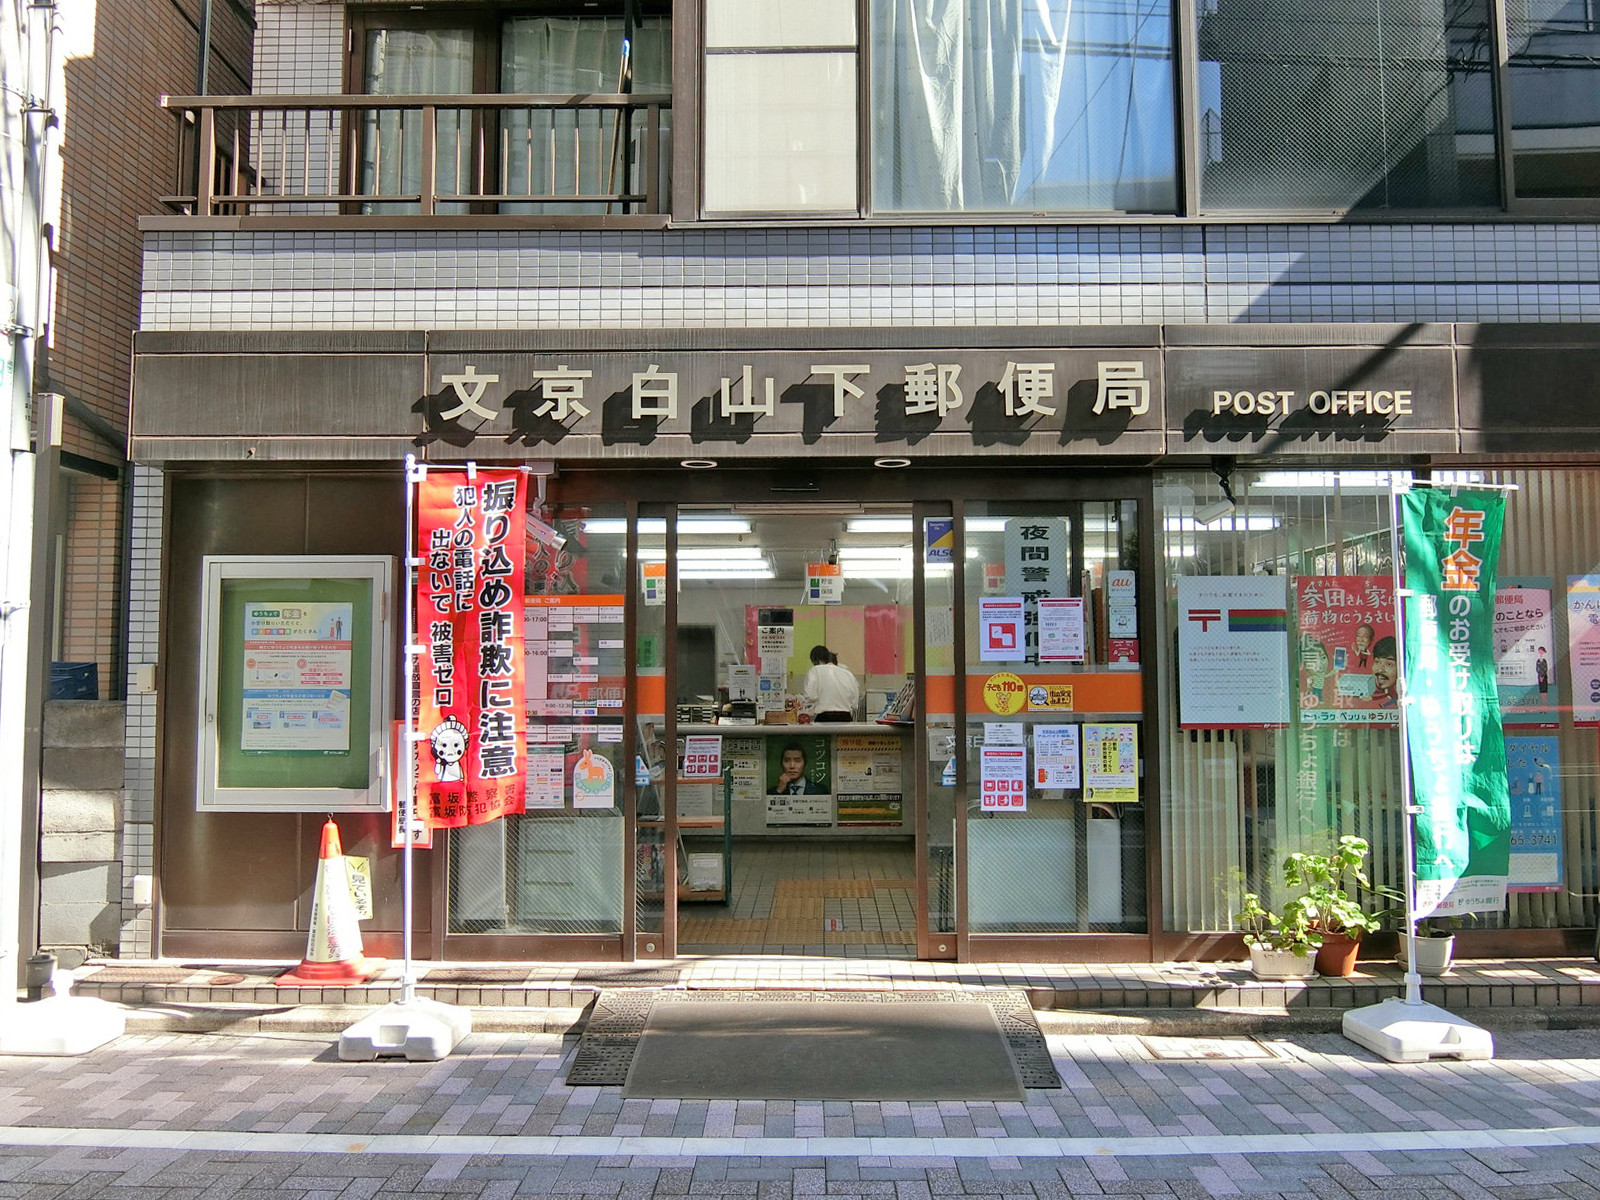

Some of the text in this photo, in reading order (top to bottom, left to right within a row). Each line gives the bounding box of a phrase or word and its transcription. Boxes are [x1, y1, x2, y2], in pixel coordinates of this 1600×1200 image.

[439, 361, 1151, 420] 文京白山下郵便局
[1213, 390, 1413, 416] POST OFFICE
[454, 485, 476, 611] 犯人の電話に
[1112, 578, 1132, 587] au
[430, 529, 454, 708] 出ないで 被害ゼロ
[478, 478, 517, 780] 振り込め詐欺に注意
[762, 627, 785, 635] ご案内
